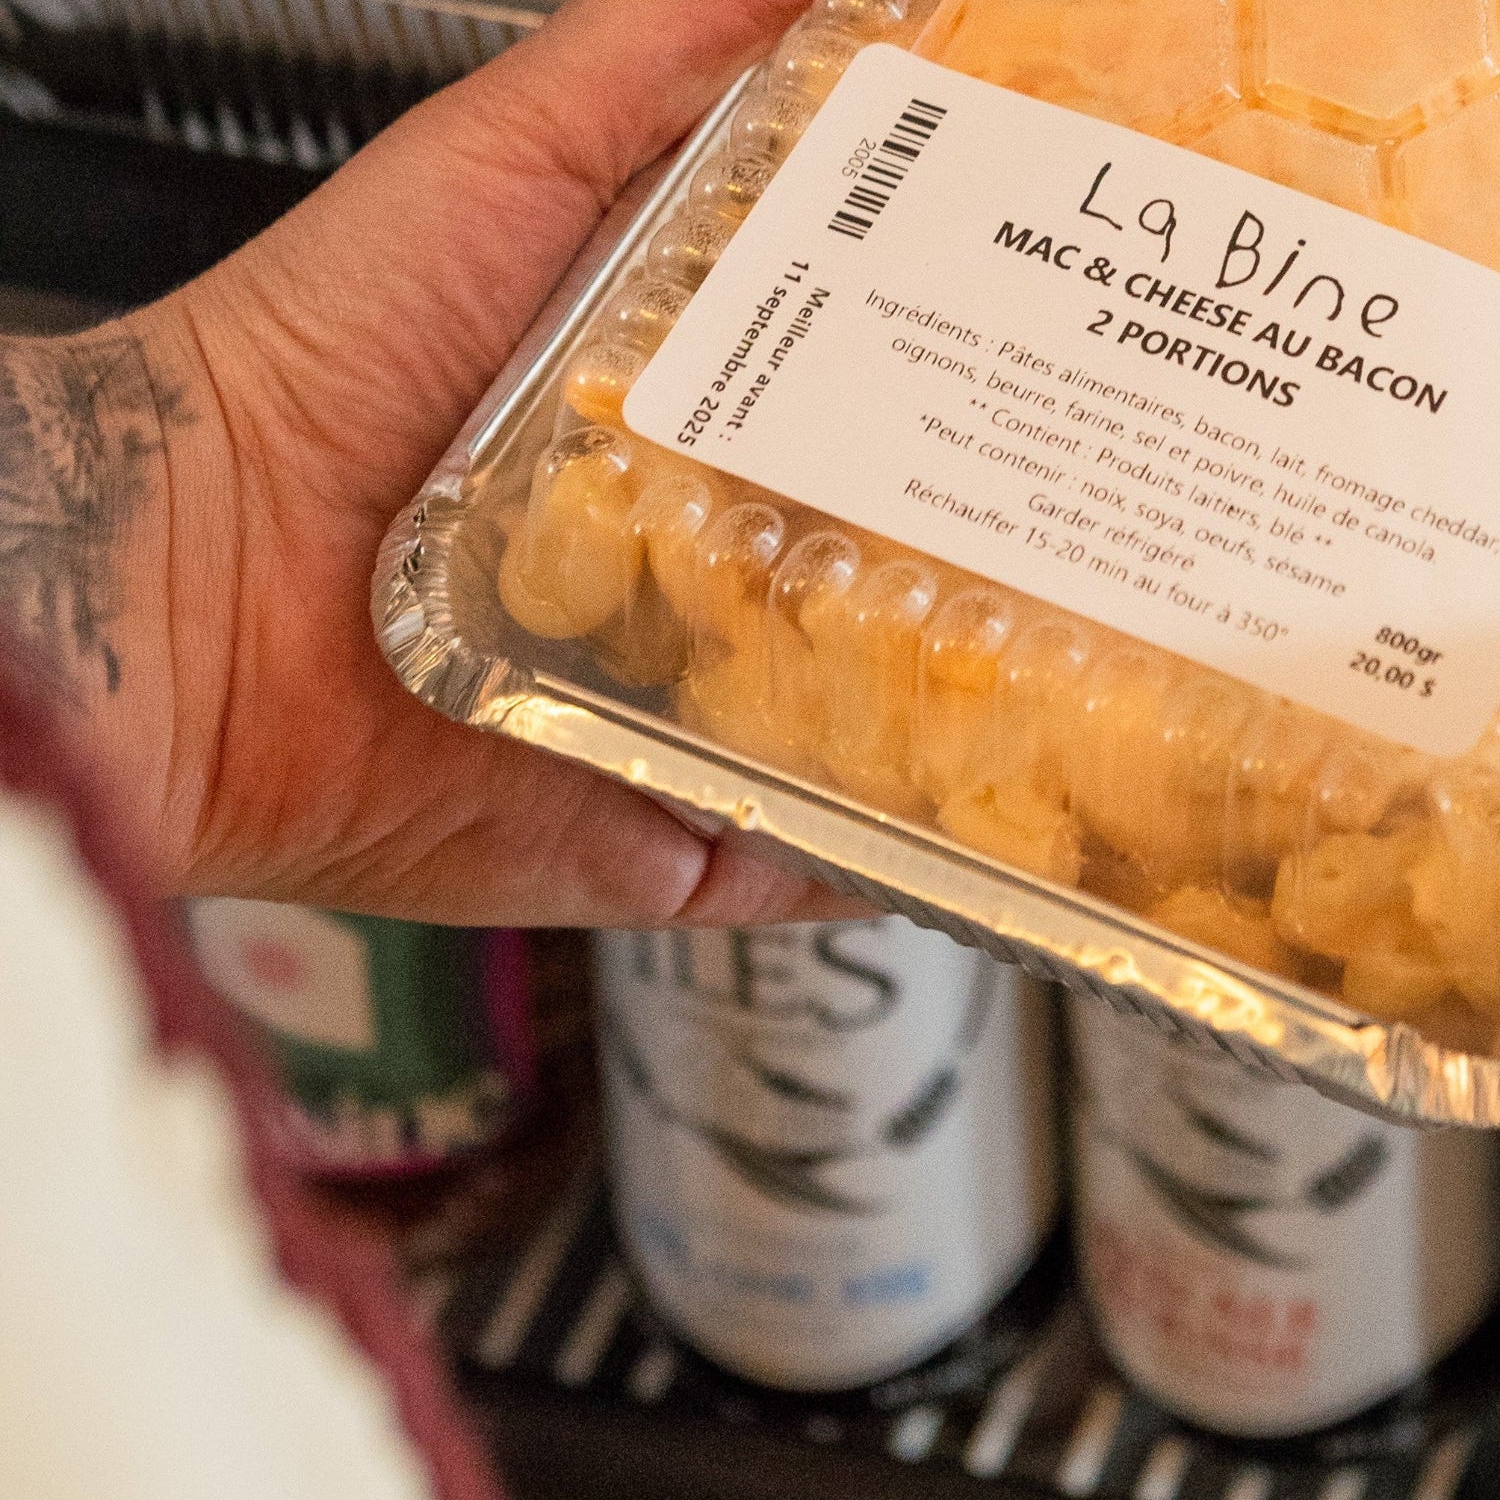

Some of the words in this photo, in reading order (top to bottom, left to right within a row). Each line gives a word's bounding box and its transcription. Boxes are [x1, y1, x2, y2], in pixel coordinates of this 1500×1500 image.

[841, 137, 876, 178] 2005
[783, 260, 809, 283] 11
[1078, 161, 1177, 263] La
[1214, 209, 1399, 338] Bine
[710, 285, 787, 393] septembre
[766, 286, 831, 371] Meilleur
[992, 219, 1081, 271] MAC
[1082, 255, 1117, 287] &
[1123, 272, 1253, 336] CHEESE
[1251, 321, 1312, 358] AU
[1314, 343, 1448, 414] BACON
[1085, 308, 1114, 336] 2
[1116, 319, 1301, 408] PORTIONS
[676, 395, 720, 445] 2025
[725, 372, 771, 430] avant
[864, 288, 981, 347] Ingrédients
[996, 340, 1055, 376] Pâtes
[1057, 368, 1184, 429] alimentaires,
[1192, 414, 1260, 460] bacon,
[1314, 464, 1405, 512] fromage
[1409, 506, 1498, 554] cheddar,
[890, 337, 976, 384] oignons,
[985, 369, 1056, 414] beurre,
[1064, 400, 1124, 439] farine,
[1132, 430, 1167, 451] sel
[1167, 445, 1191, 463] et
[1191, 456, 1264, 496] poivre,
[1272, 482, 1326, 517] huile
[1331, 507, 1360, 530] de
[977, 442, 1066, 483] contenir
[1079, 481, 1126, 512] noix,
[1134, 502, 1184, 535] soya,
[990, 407, 1081, 455] Contient
[1095, 446, 1184, 496] Produits
[1187, 484, 1260, 530] laitiers,
[1027, 492, 1100, 532] Garder
[903, 477, 1019, 535] Réchauffer
[1025, 526, 1085, 563] 15-20
[1087, 555, 1129, 582] min
[1132, 574, 1161, 595] au
[1166, 582, 1212, 613] four
[1348, 650, 1415, 689] 20,00
[1374, 625, 1443, 666] 800gr
